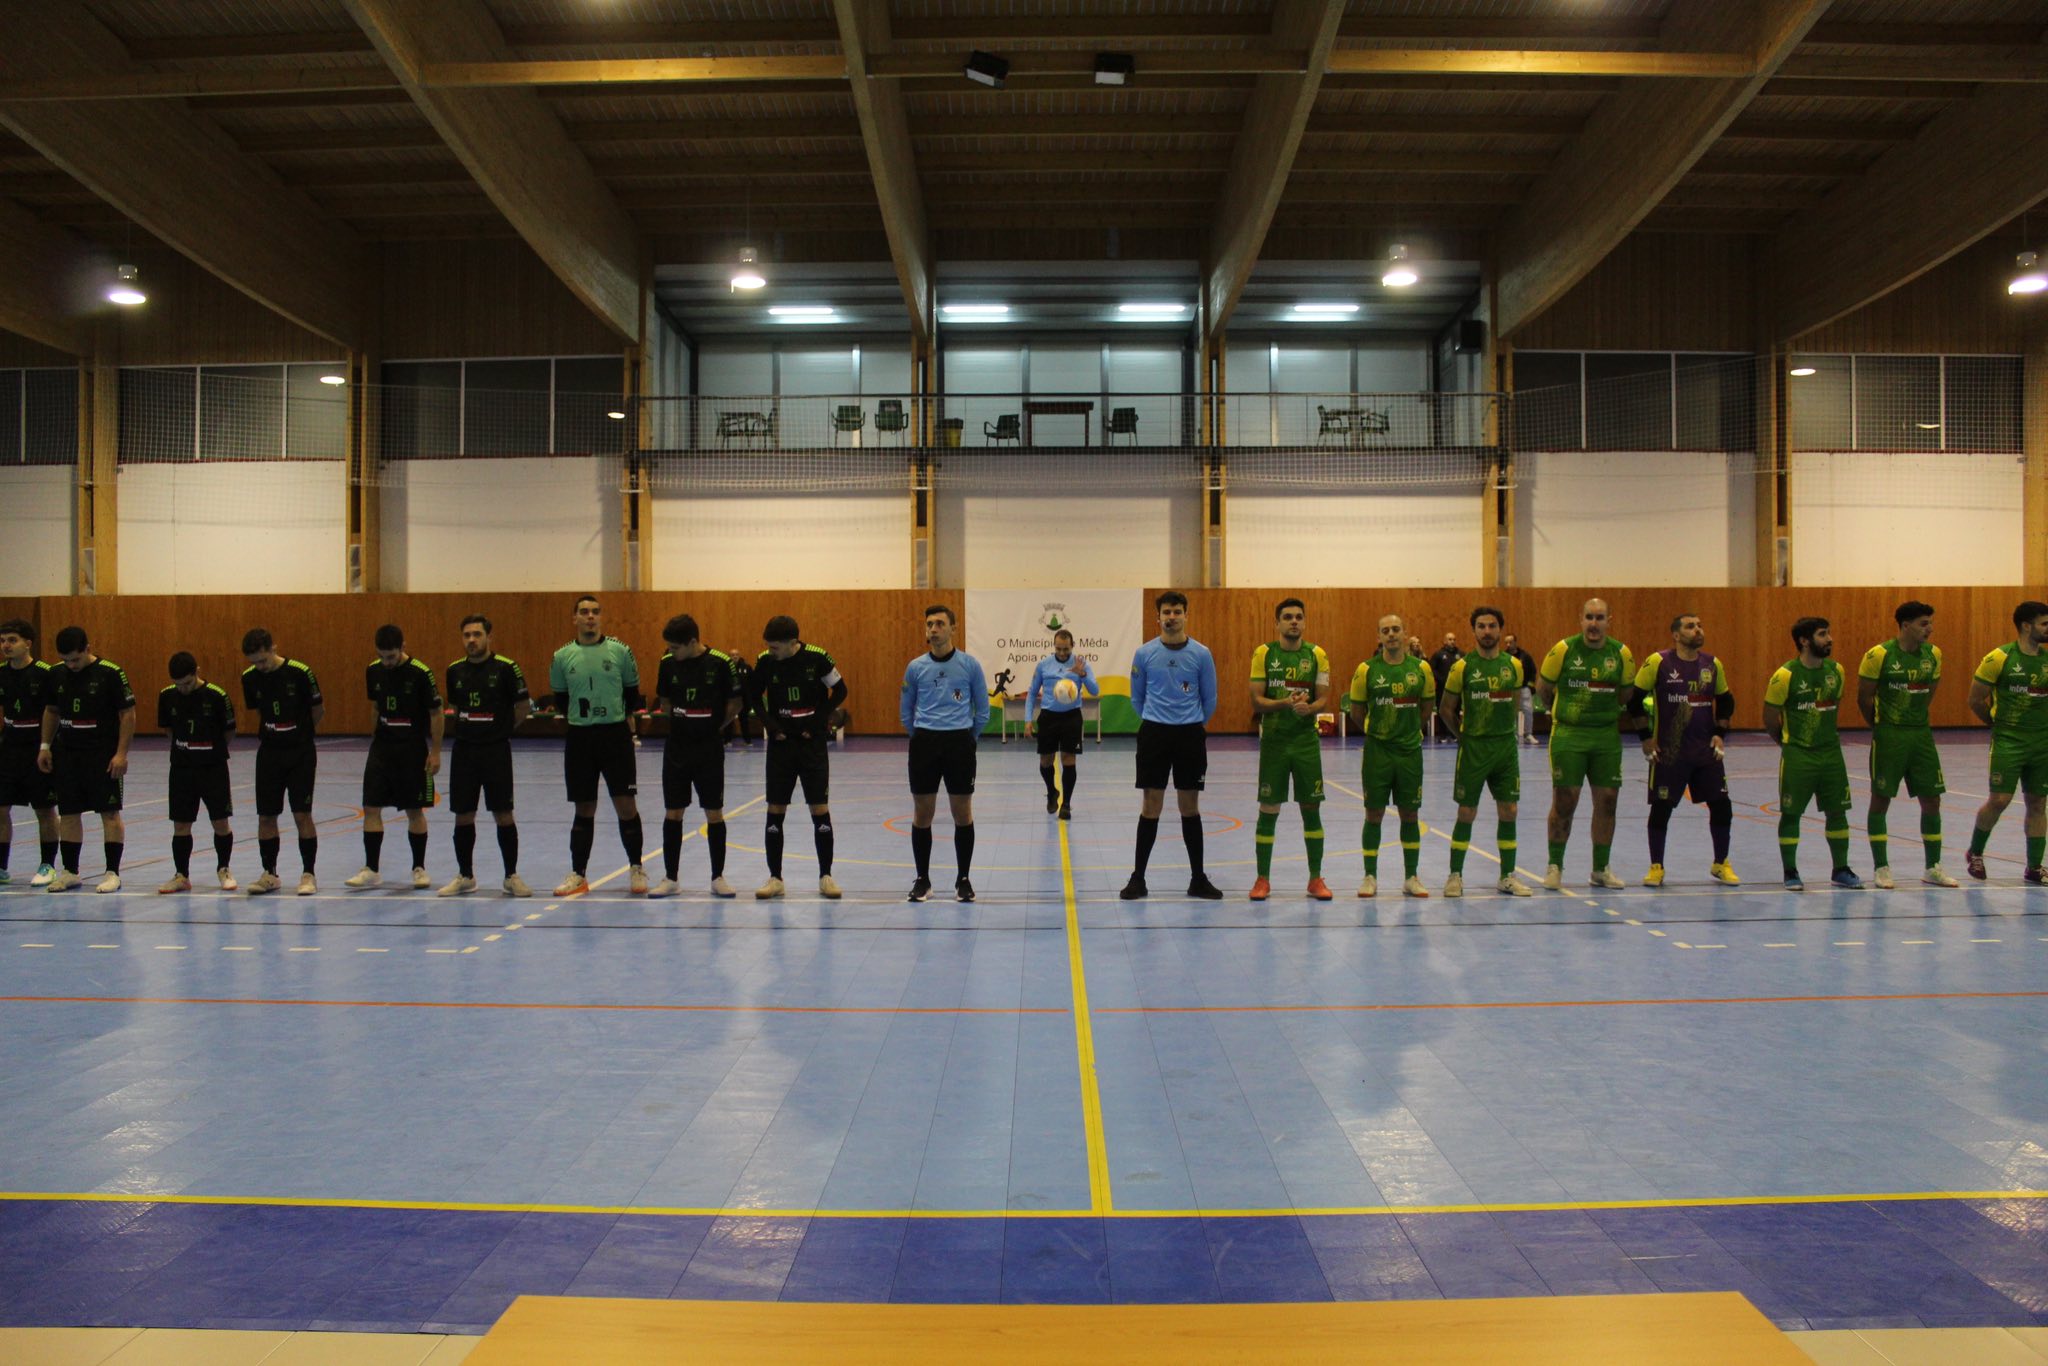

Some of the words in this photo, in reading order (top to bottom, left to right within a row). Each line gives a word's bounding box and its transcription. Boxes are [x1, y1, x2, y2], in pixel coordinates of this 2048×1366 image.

[997, 639, 1006, 648] O
[1009, 638, 1055, 650] Municípi
[1079, 638, 1109, 648] Mêda
[1007, 653, 1038, 664] Apoia
[1285, 667, 1297, 679] 21
[1591, 667, 1598, 679] 9
[1907, 669, 1918, 680] 17
[2030, 673, 2038, 685] 2
[1391, 682, 1404, 694] 88
[1487, 676, 1499, 689] 12
[1688, 681, 1697, 692] 71
[469, 692, 481, 707] 15
[788, 686, 800, 702] 10
[1814, 687, 1821, 700] 7
[14, 699, 21, 712] 4
[73, 698, 80, 712] 6
[386, 696, 397, 711] 13
[188, 720, 195, 734] 7
